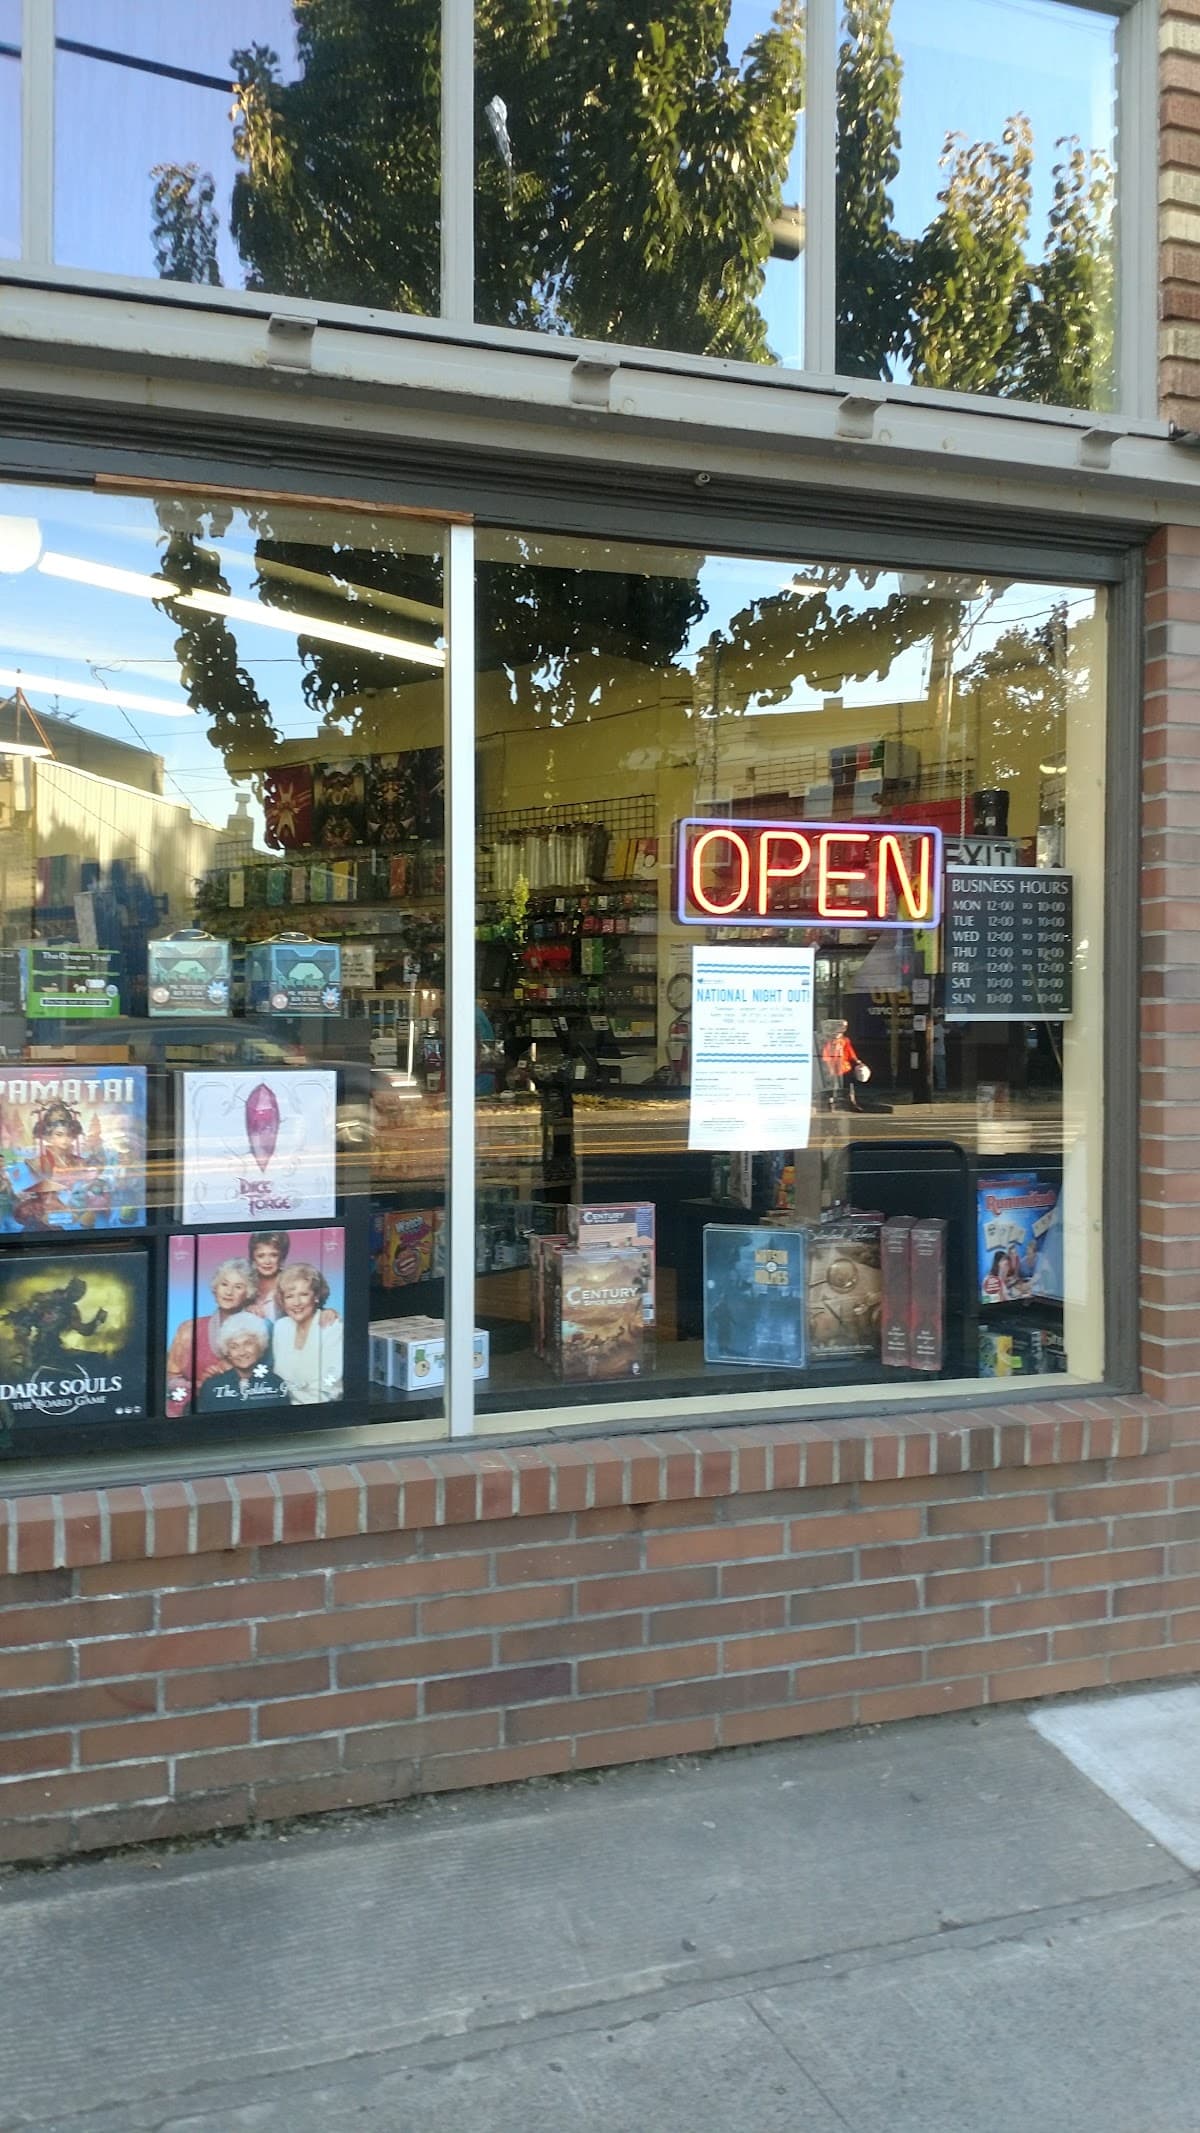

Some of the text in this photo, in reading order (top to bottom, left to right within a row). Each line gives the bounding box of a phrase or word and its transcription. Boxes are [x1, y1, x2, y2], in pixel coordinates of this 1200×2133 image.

[944, 844, 1012, 866] EXIT
[691, 829, 931, 919] OPEN
[952, 879, 1069, 895] BUSINESS HOURS
[952, 900, 982, 911] MON
[952, 915, 975, 926] TUE
[952, 931, 980, 942] WED
[952, 946, 977, 958] THU
[952, 962, 969, 973] FRI
[952, 977, 973, 989] SAT
[697, 988, 810, 1002] NATIONAL NIGHT OUT!
[952, 993, 976, 1004] SUN
[237, 1177, 272, 1194] DICE
[582, 1211, 625, 1223] CENTURY
[566, 1286, 639, 1305] CENTURY
[0, 1376, 122, 1400] DARK SOULS
[213, 1384, 239, 1398] The
[12, 1402, 33, 1411] THE
[74, 1395, 107, 1406] GAME
